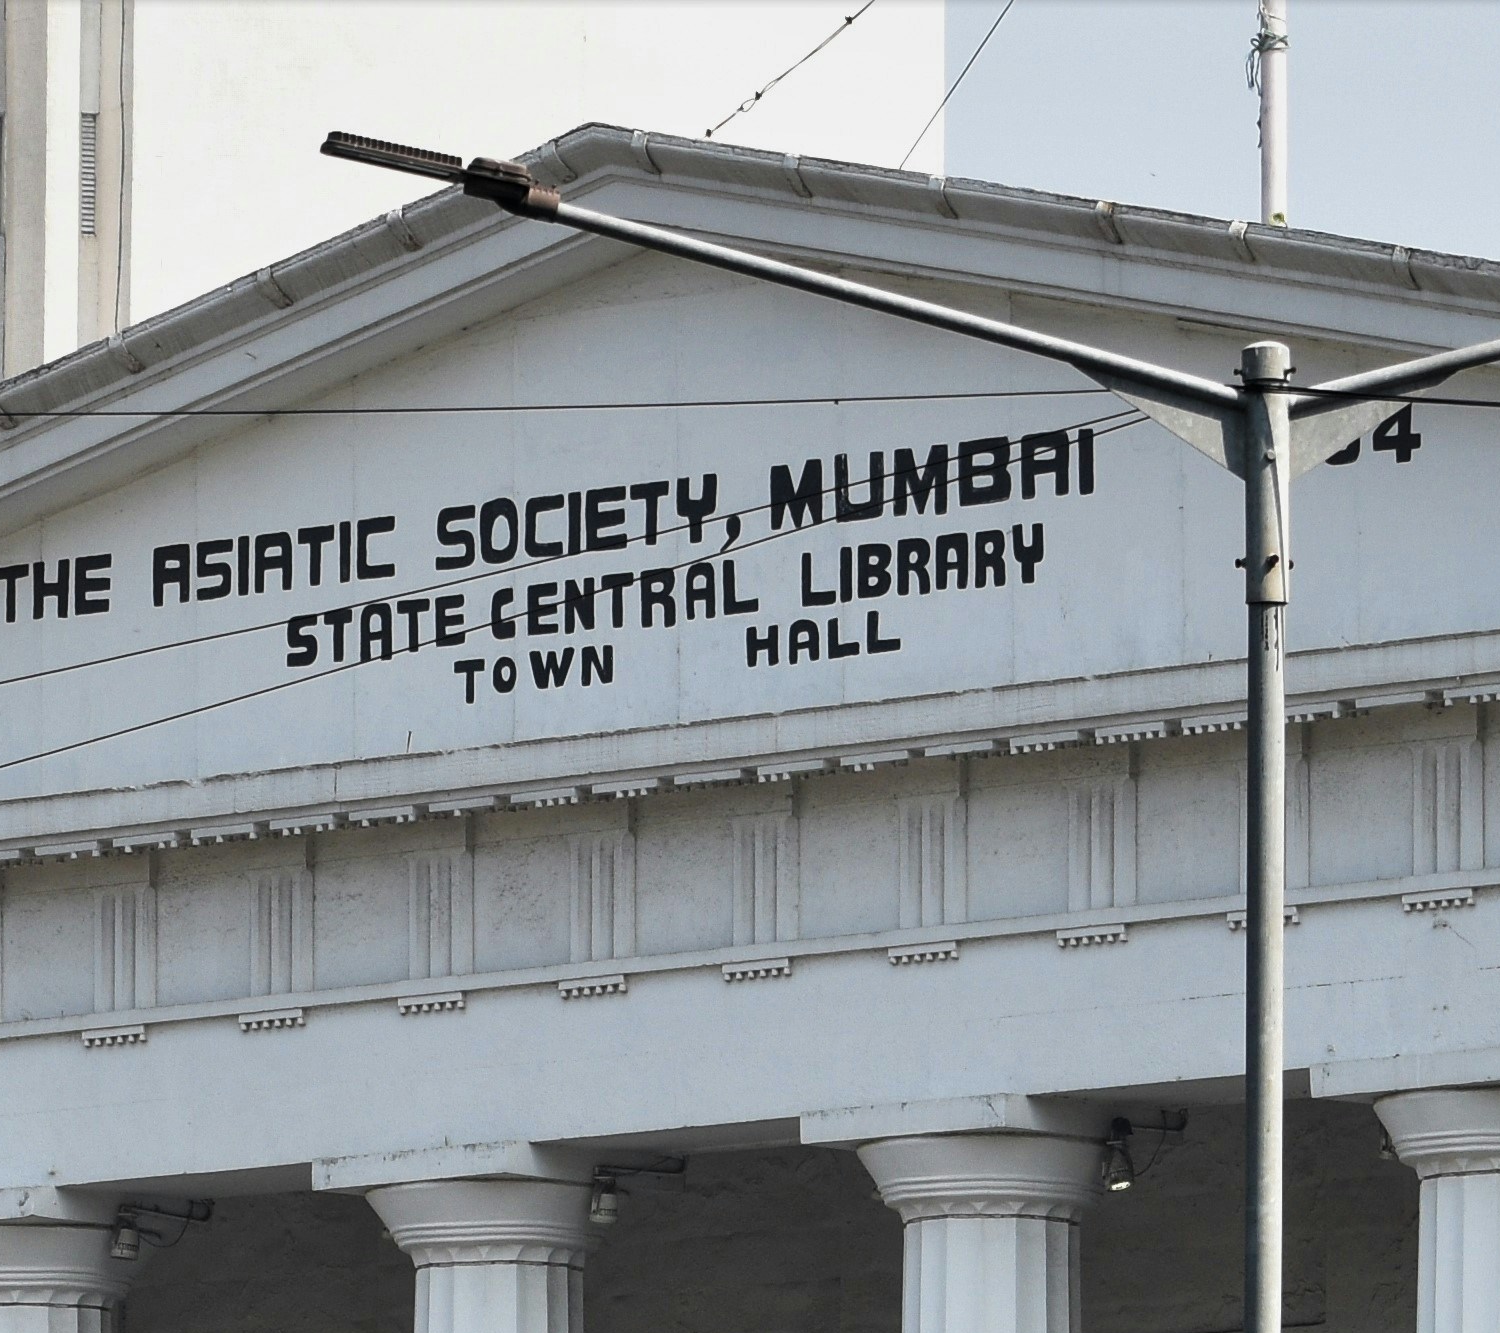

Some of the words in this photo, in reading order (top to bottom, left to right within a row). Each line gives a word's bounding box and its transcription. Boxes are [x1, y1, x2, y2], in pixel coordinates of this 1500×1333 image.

[152, 516, 396, 608] ASIATIC
[435, 473, 743, 570] SOCIETY,
[771, 428, 1095, 530] MUMBAI
[287, 594, 466, 668] STATE
[491, 559, 760, 640] CENTRAL
[801, 523, 1045, 607] LIBRARY
[454, 645, 614, 702] TOWN
[746, 611, 902, 667] HALL
